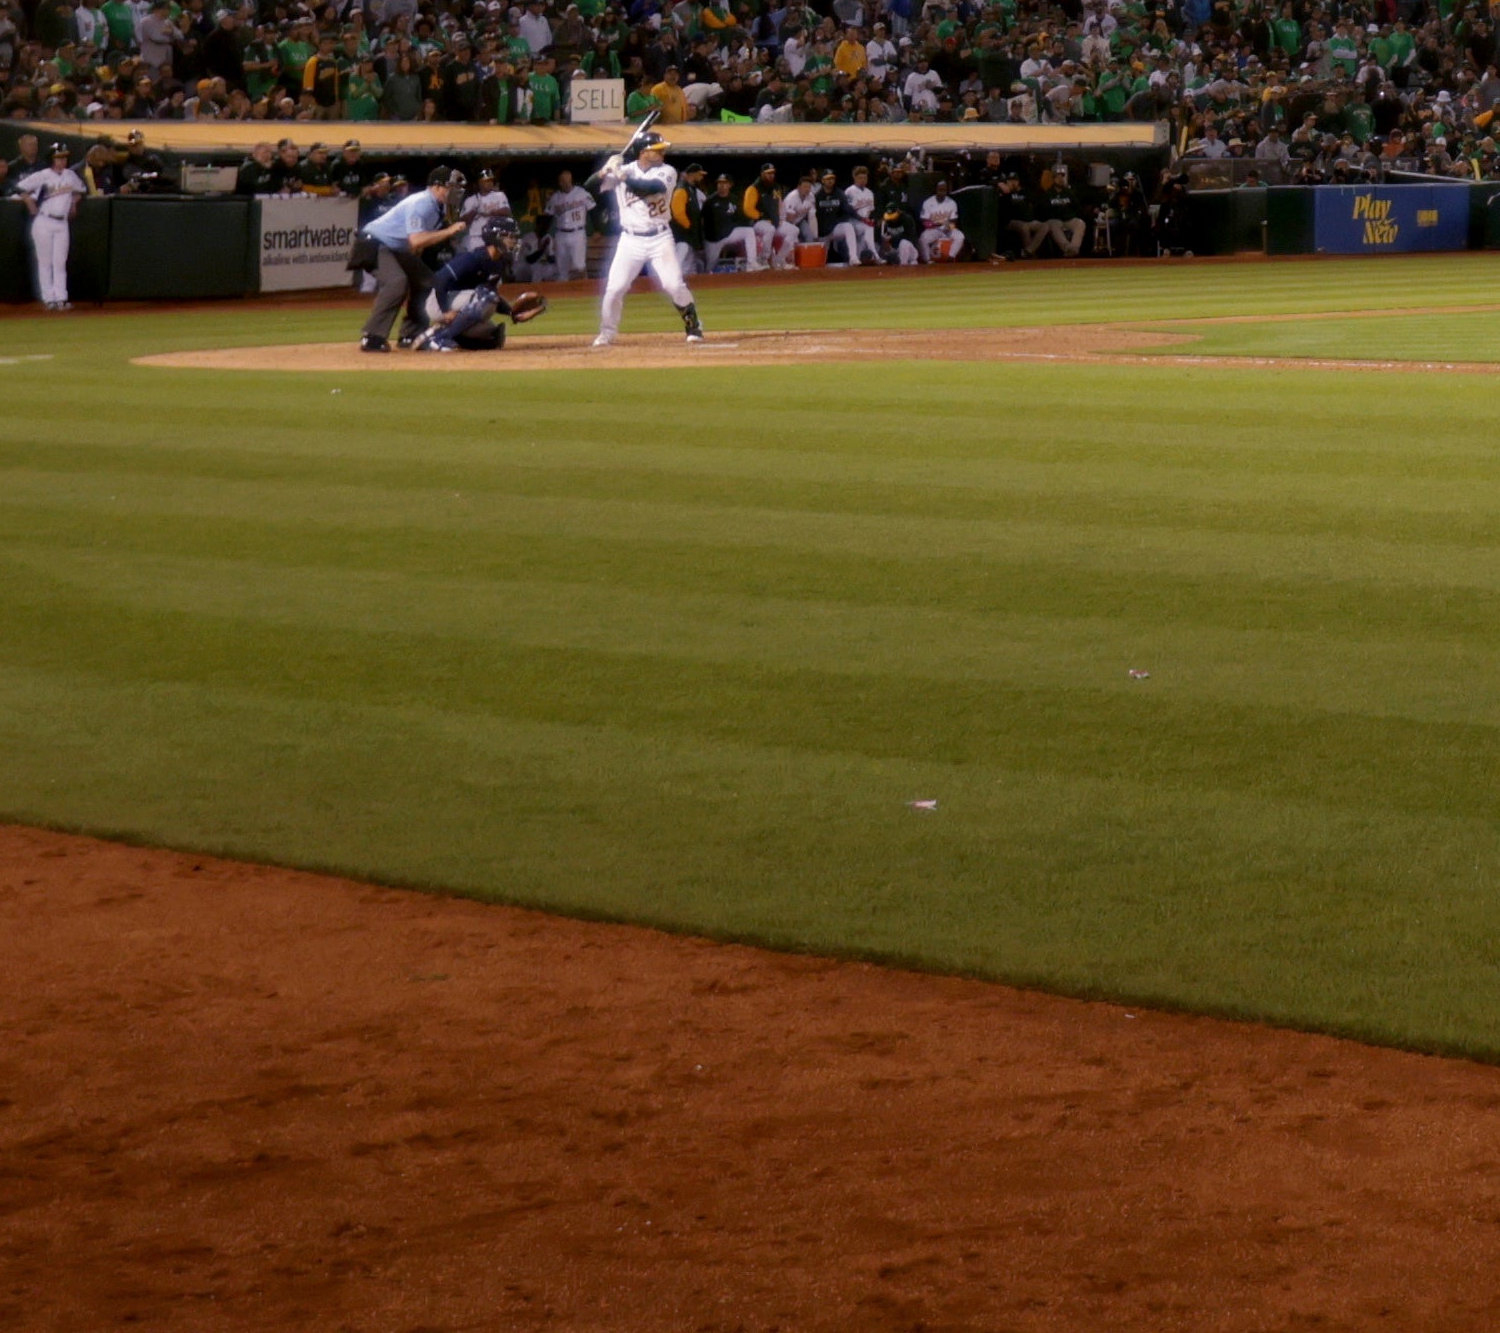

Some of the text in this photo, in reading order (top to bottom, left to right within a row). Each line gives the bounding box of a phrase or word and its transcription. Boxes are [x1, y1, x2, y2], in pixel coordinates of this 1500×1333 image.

[574, 88, 621, 111] SELL
[571, 211, 581, 222] 15
[648, 198, 666, 218] 22
[1352, 193, 1392, 221] Play
[263, 224, 354, 251] smartwater
[1363, 218, 1399, 245] New
[262, 253, 293, 266] alkaline
[294, 252, 311, 265] with
